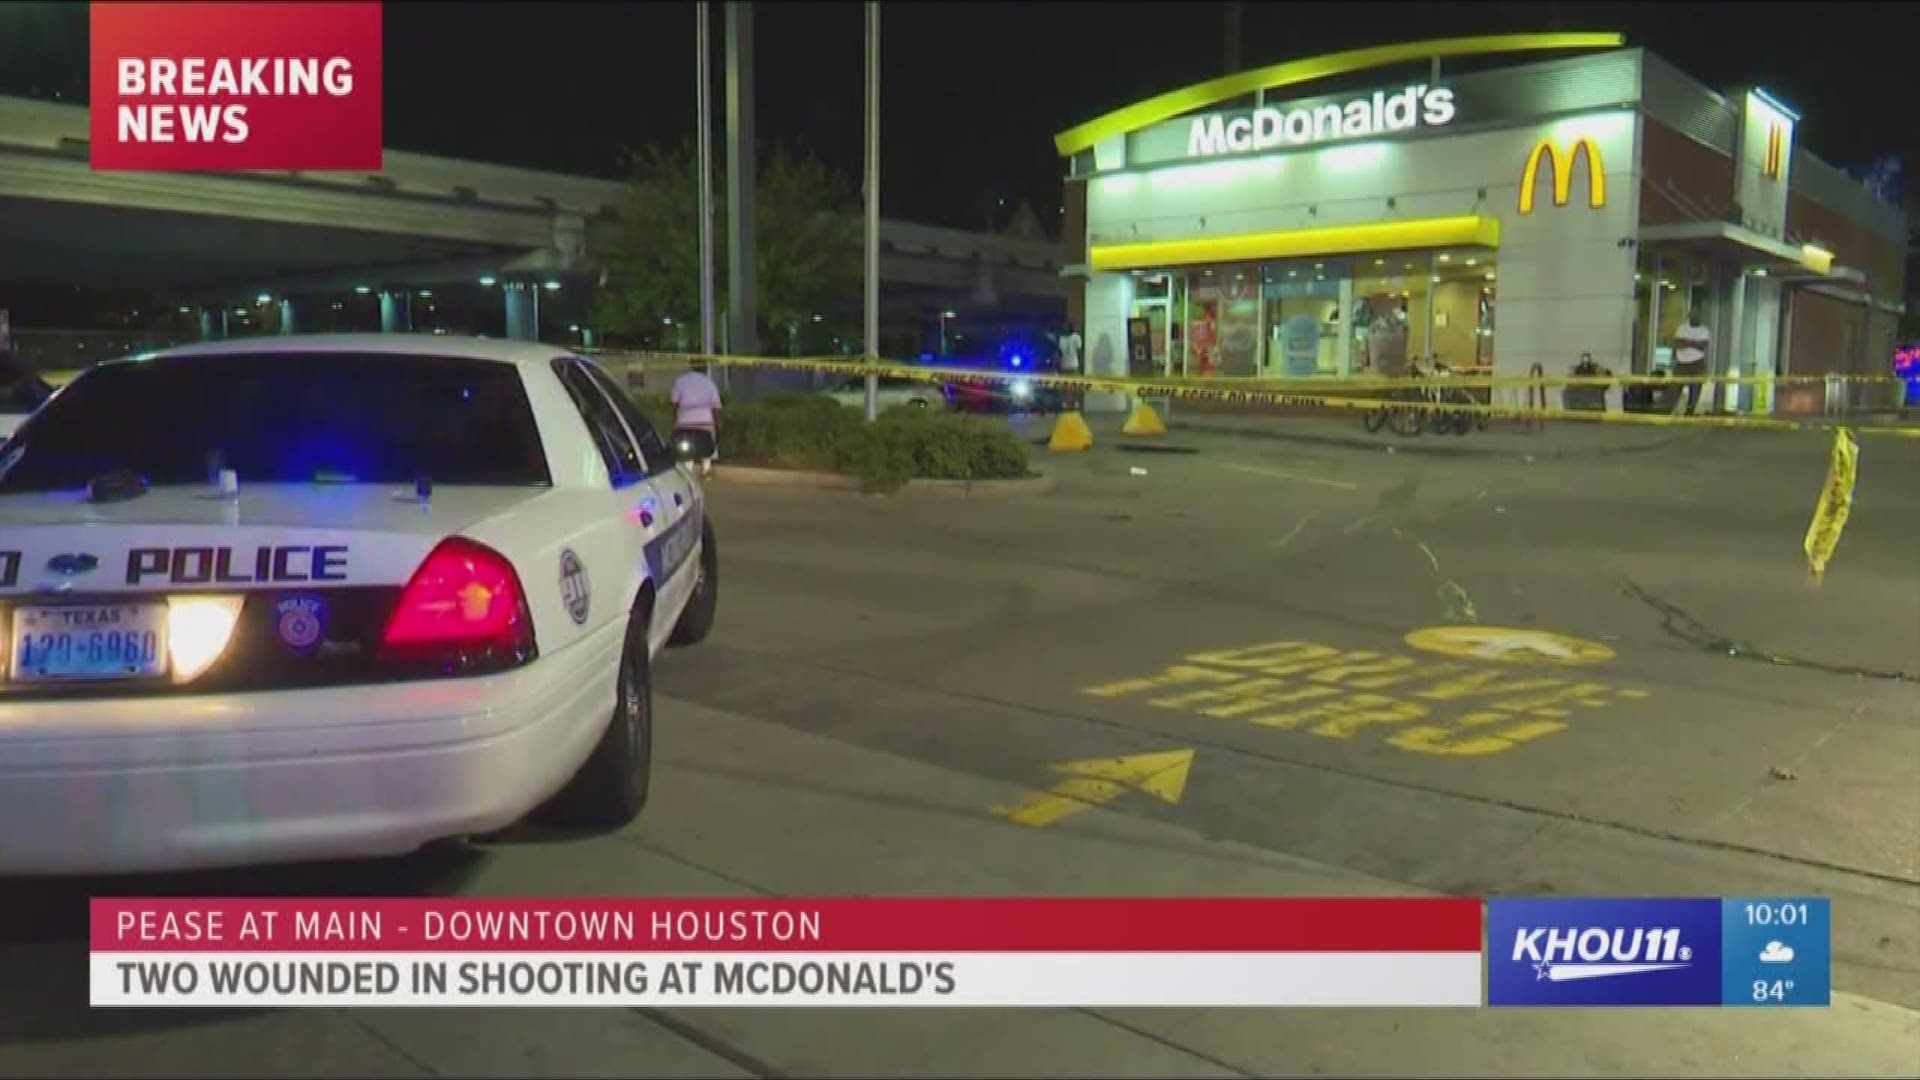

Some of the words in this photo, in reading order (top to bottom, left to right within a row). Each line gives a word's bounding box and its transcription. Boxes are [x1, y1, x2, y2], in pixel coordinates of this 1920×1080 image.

[1187, 84, 1456, 156] McDonald's
[1136, 386, 1178, 398] CRIME
[126, 546, 348, 585] POLICE
[63, 608, 121, 626] TEXAS
